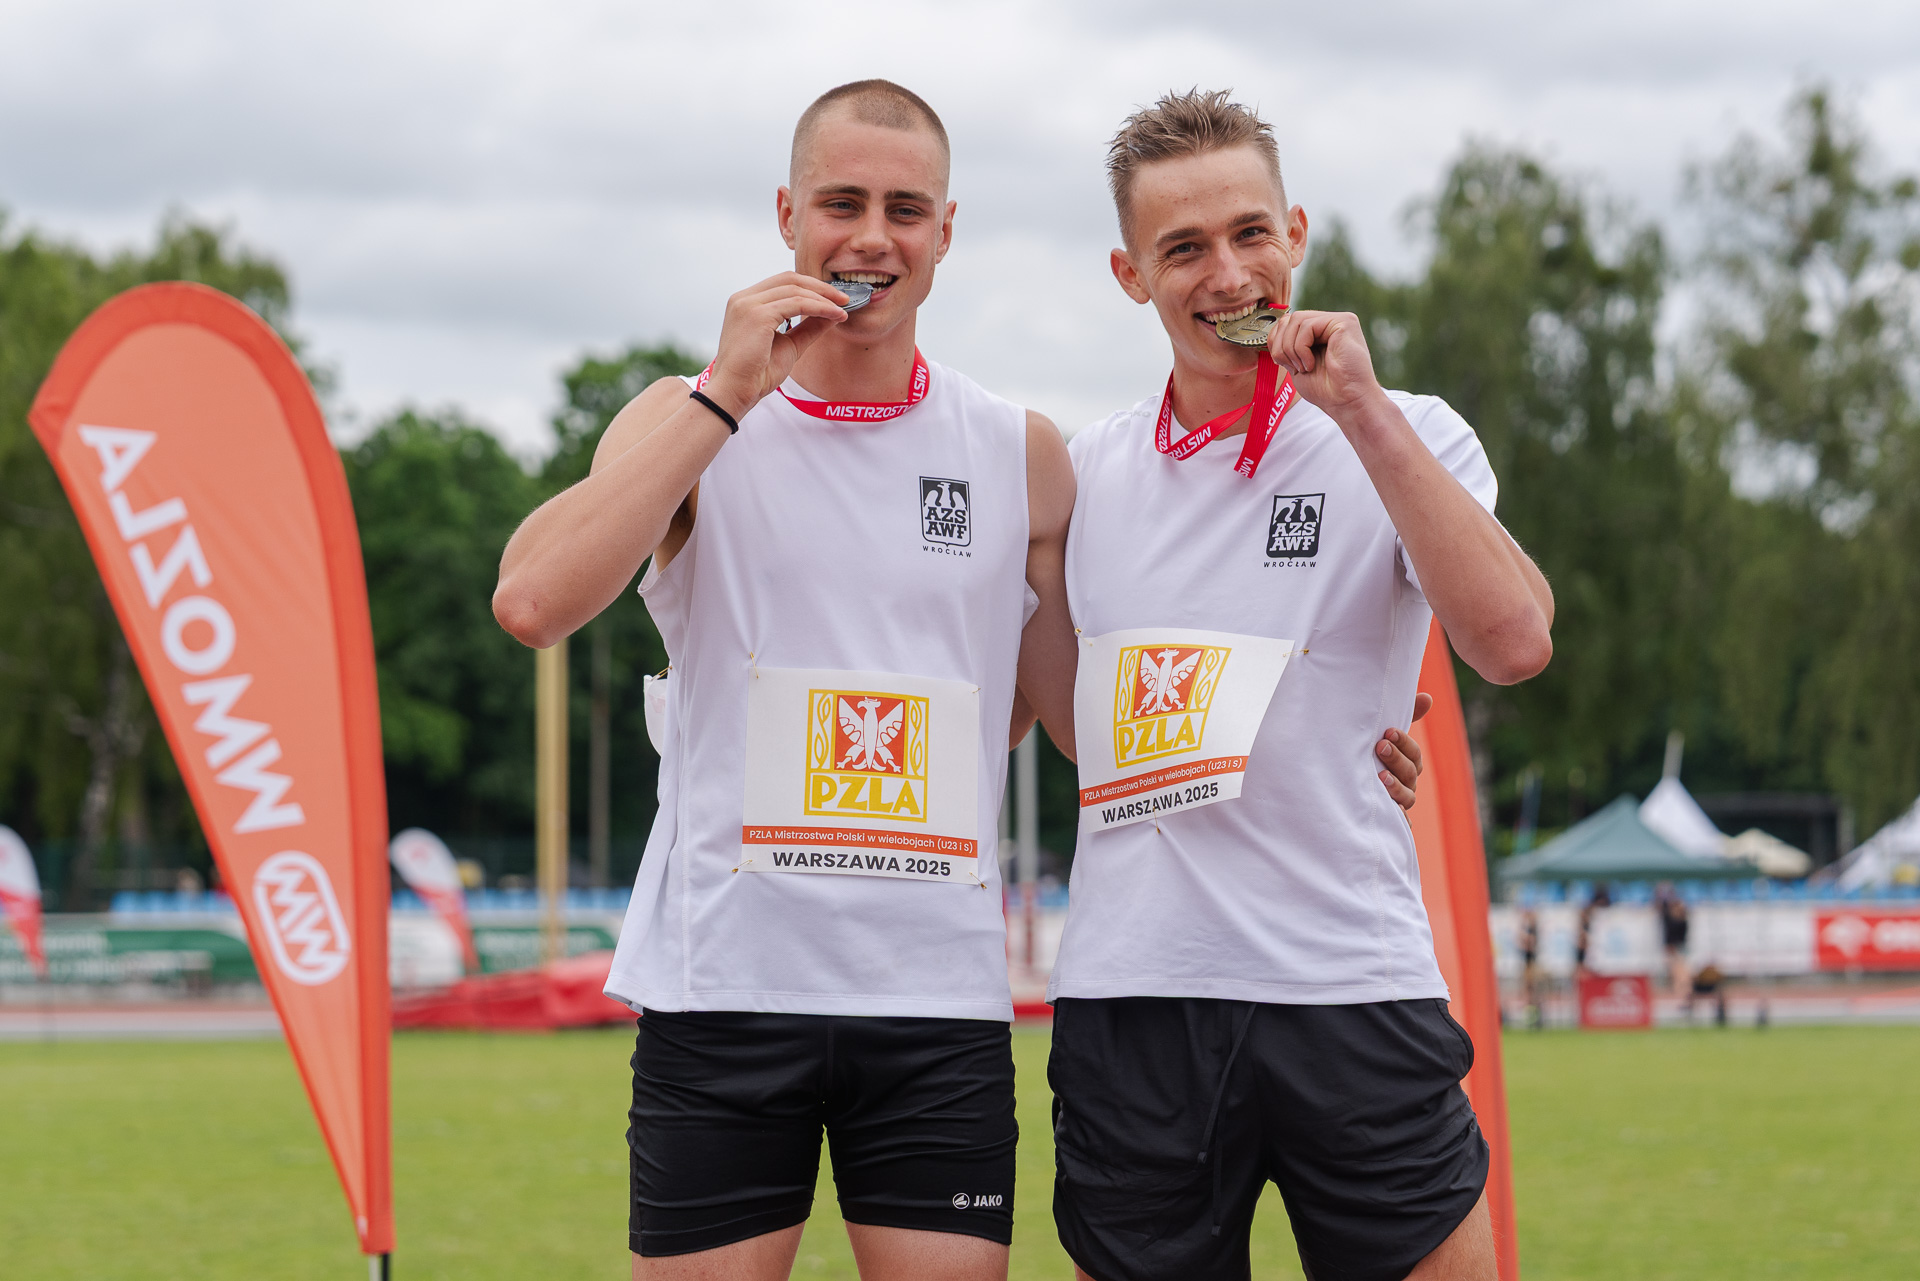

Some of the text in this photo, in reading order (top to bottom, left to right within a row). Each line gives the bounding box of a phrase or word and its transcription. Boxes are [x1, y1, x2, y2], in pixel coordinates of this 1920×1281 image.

[912, 364, 927, 402] MIST
[925, 506, 966, 524] AZS
[926, 521, 967, 539] AWF
[1272, 522, 1317, 538] AZS
[1269, 536, 1315, 552] AWF
[1118, 714, 1196, 760] PZLA
[1084, 790, 1100, 801] PZLA
[1101, 781, 1138, 797] Mistrzostwa
[1139, 774, 1157, 787] Polski
[1157, 775, 1164, 783] w
[1164, 763, 1206, 780] wielobojach
[1207, 760, 1227, 772] (U23
[811, 774, 921, 815] PZLA
[1102, 782, 1218, 824] WARSZAWA 2025
[749, 830, 773, 839] PZLA
[775, 830, 834, 840] Mistrzostwa
[836, 832, 865, 842] Polski
[867, 834, 876, 842] w
[878, 834, 935, 848] wielobojach
[937, 837, 958, 850] (U23
[963, 841, 973, 854] S)
[773, 852, 951, 876] WARSZAWA 2025
[973, 1194, 1003, 1207] JAKO
